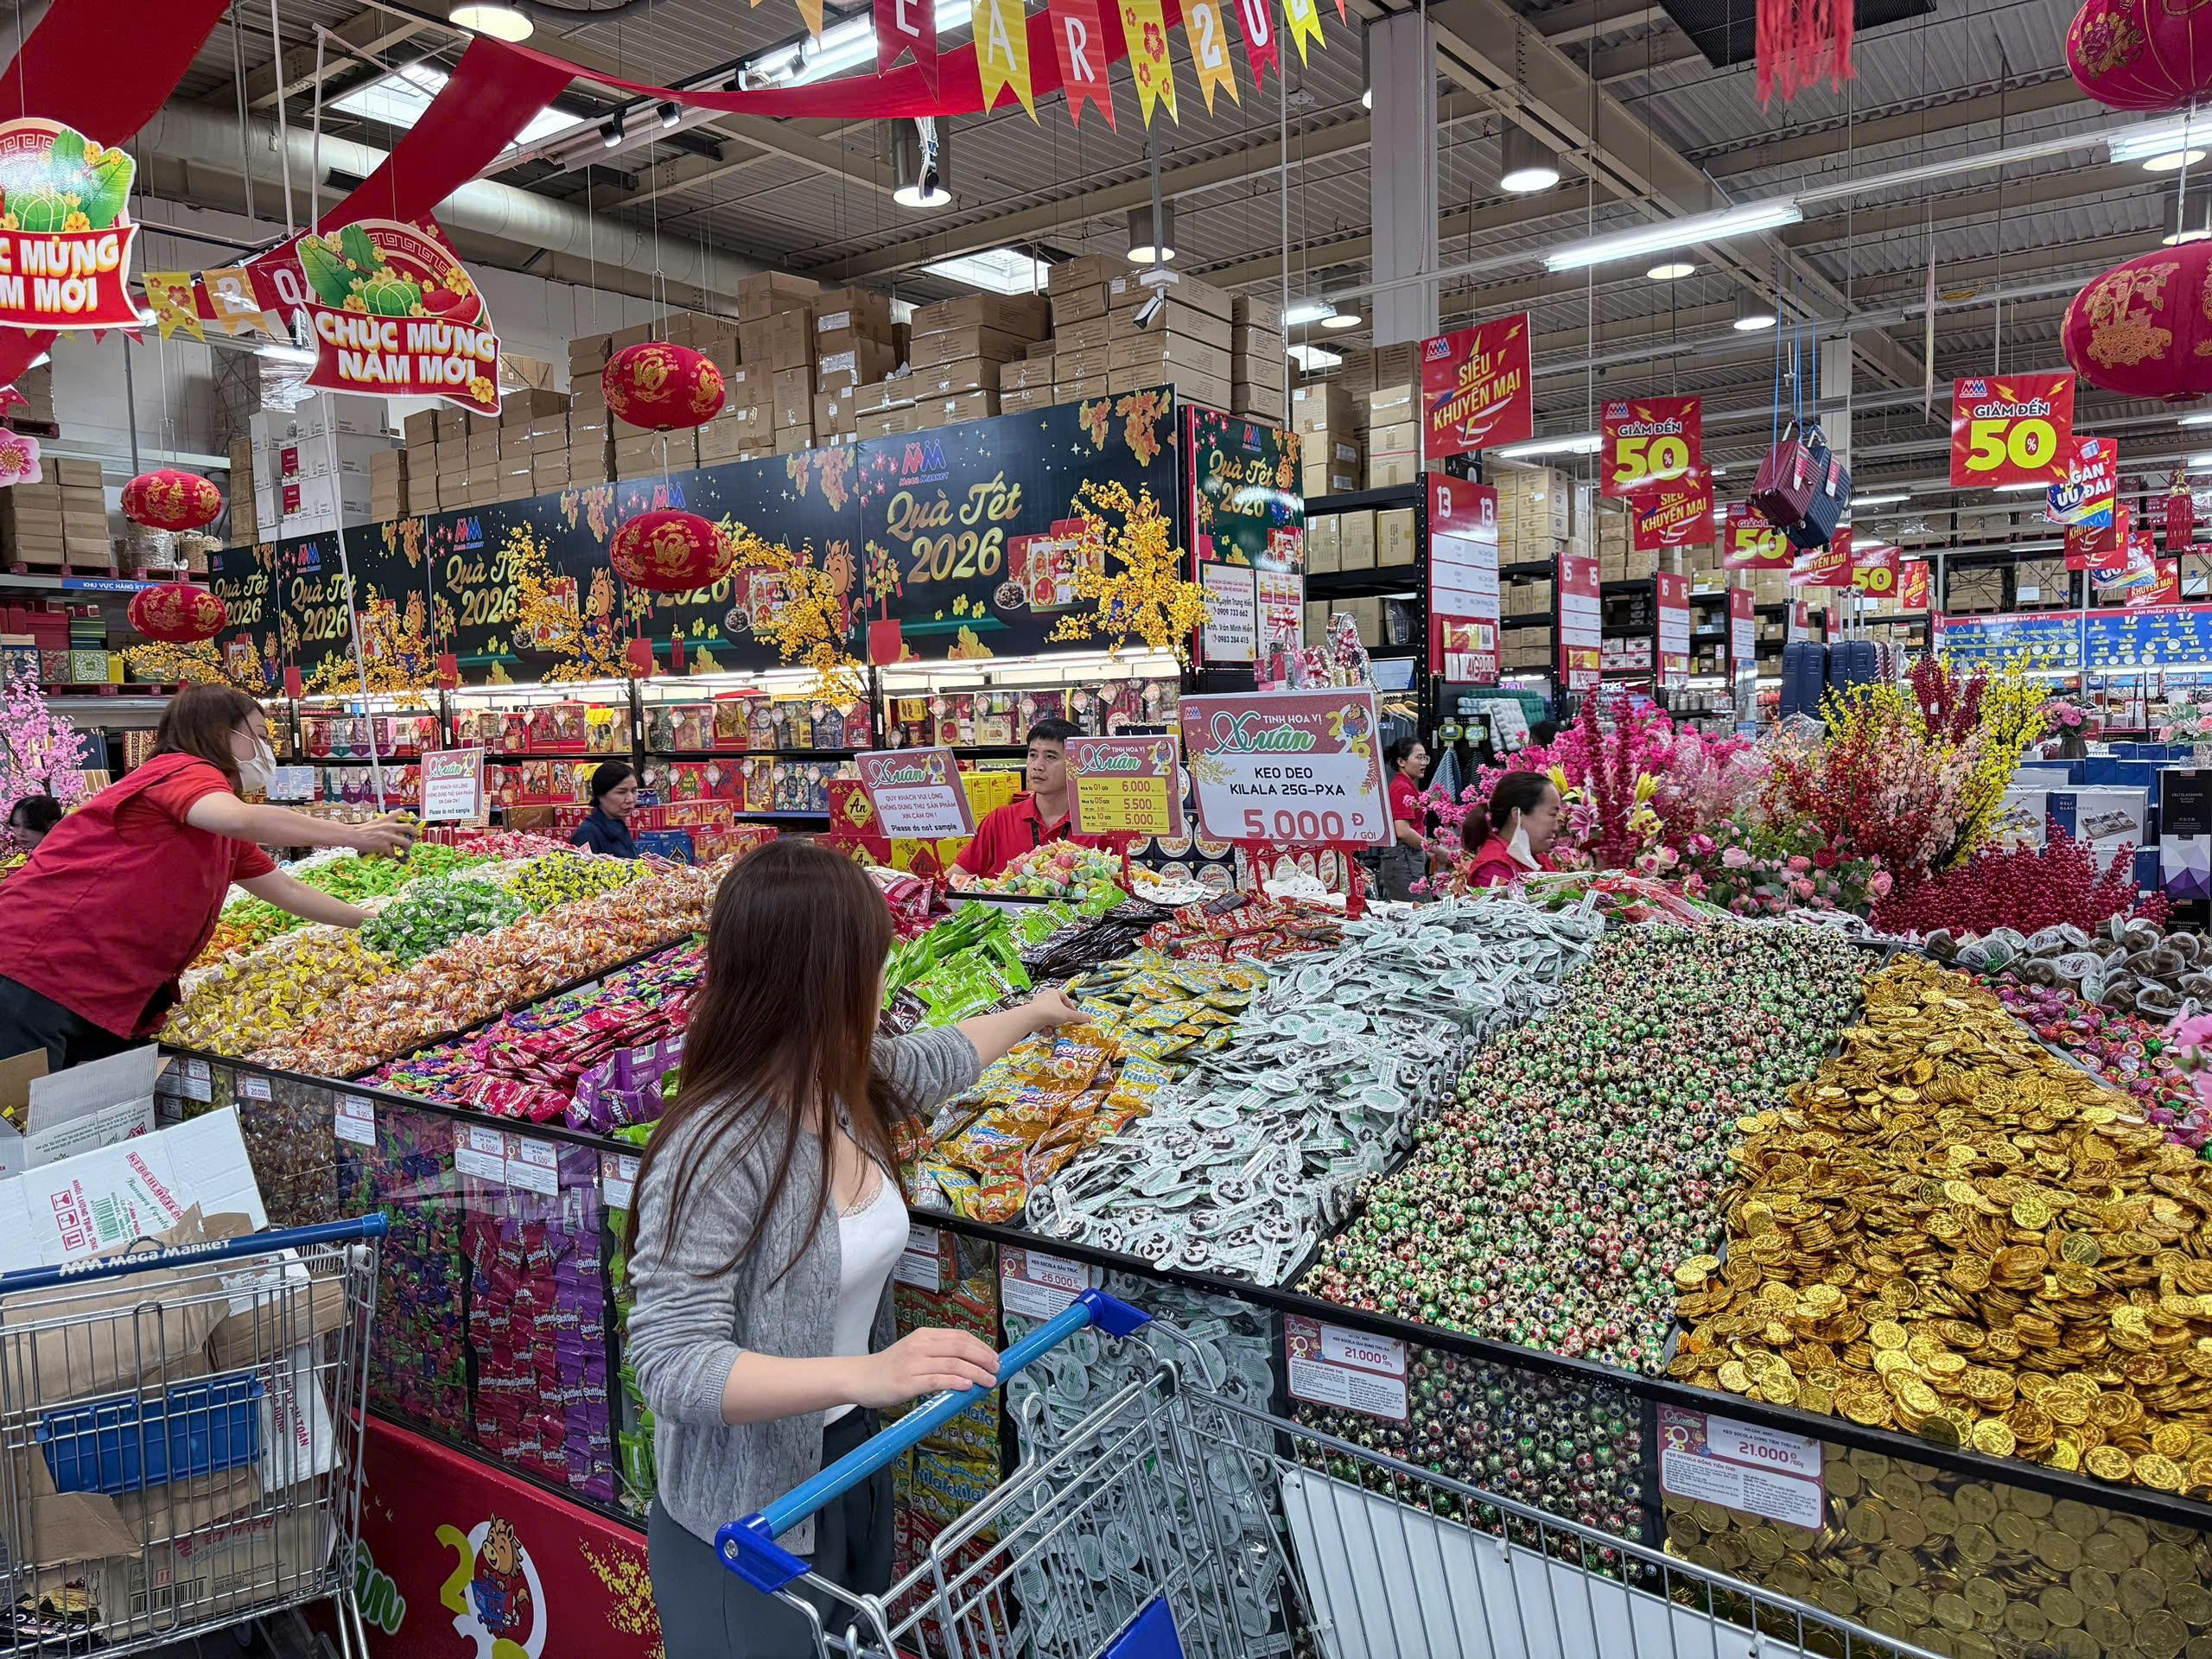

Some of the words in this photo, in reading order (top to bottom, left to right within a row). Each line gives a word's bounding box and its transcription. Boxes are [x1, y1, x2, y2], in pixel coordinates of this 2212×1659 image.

[1459, 352, 1491, 387] SIÊU
[1433, 382, 1491, 432] KHUYẾN
[1974, 401, 2015, 418] GIẢM
[2017, 397, 2050, 416] ĐẾN
[1618, 421, 1652, 436] GIẢM
[1654, 417, 1682, 435] ĐẾN
[1209, 449, 1243, 484] Quà
[1245, 457, 1274, 487] Tết
[1611, 436, 1689, 483] 50
[887, 488, 954, 542] Quà
[959, 470, 1022, 525] Tết
[1437, 486, 1452, 518] 13
[1480, 497, 1494, 527] 13
[1641, 505, 1684, 534] KHUYẾN
[907, 527, 1004, 583] 2026
[244, 568, 270, 596] Tết
[447, 553, 487, 594] Quà
[291, 575, 324, 613] Quà
[460, 584, 518, 626] 2026
[302, 604, 349, 641] 2026
[1287, 714, 1310, 724] HOA
[1205, 709, 1317, 756] Xuân
[1077, 743, 1141, 775] Xuân
[868, 759, 926, 788] Xuân
[1122, 780, 1150, 792] 6.000
[1230, 784, 1278, 796] KILALA
[849, 797, 868, 814] An
[1123, 798, 1152, 810] 5.500
[935, 822, 957, 833] sample
[1125, 813, 1153, 825] 5.000
[1243, 809, 1345, 840] 5.000
[89, 1236, 99, 1251] 5KG
[526, 1249, 548, 1263] Skittles
[577, 1258, 601, 1268] Skittles
[1041, 1272, 1072, 1287] 26.000
[489, 1317, 510, 1327] Skittles
[533, 1313, 556, 1325] Skittles
[556, 1313, 579, 1324] Skittles
[1344, 1347, 1382, 1363] 21.000
[583, 1388, 607, 1397] Skittles
[1738, 1440, 1789, 1463] 21.000
